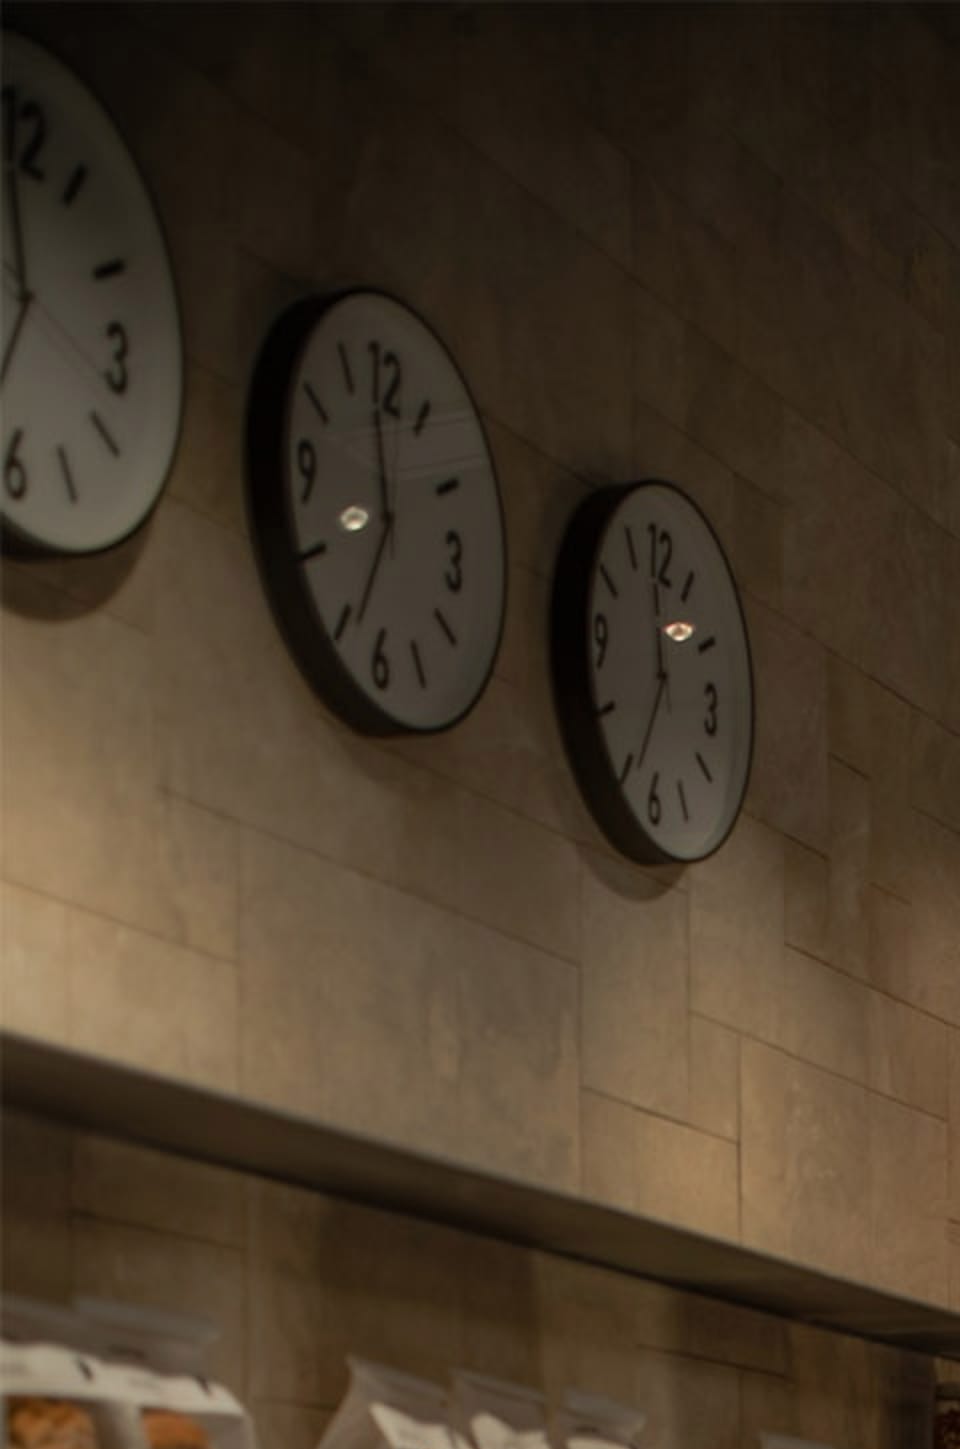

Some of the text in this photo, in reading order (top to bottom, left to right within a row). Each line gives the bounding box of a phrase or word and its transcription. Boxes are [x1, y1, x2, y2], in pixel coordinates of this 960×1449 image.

[103, 322, 129, 395] 3
[368, 340, 402, 418] 12
[3, 428, 28, 500] 6
[298, 439, 317, 504] 9
[445, 530, 463, 592] 3
[647, 522, 673, 588] 12
[370, 627, 390, 690] 6
[594, 612, 609, 669] 9
[704, 682, 718, 737] 3
[648, 771, 662, 826] 6
